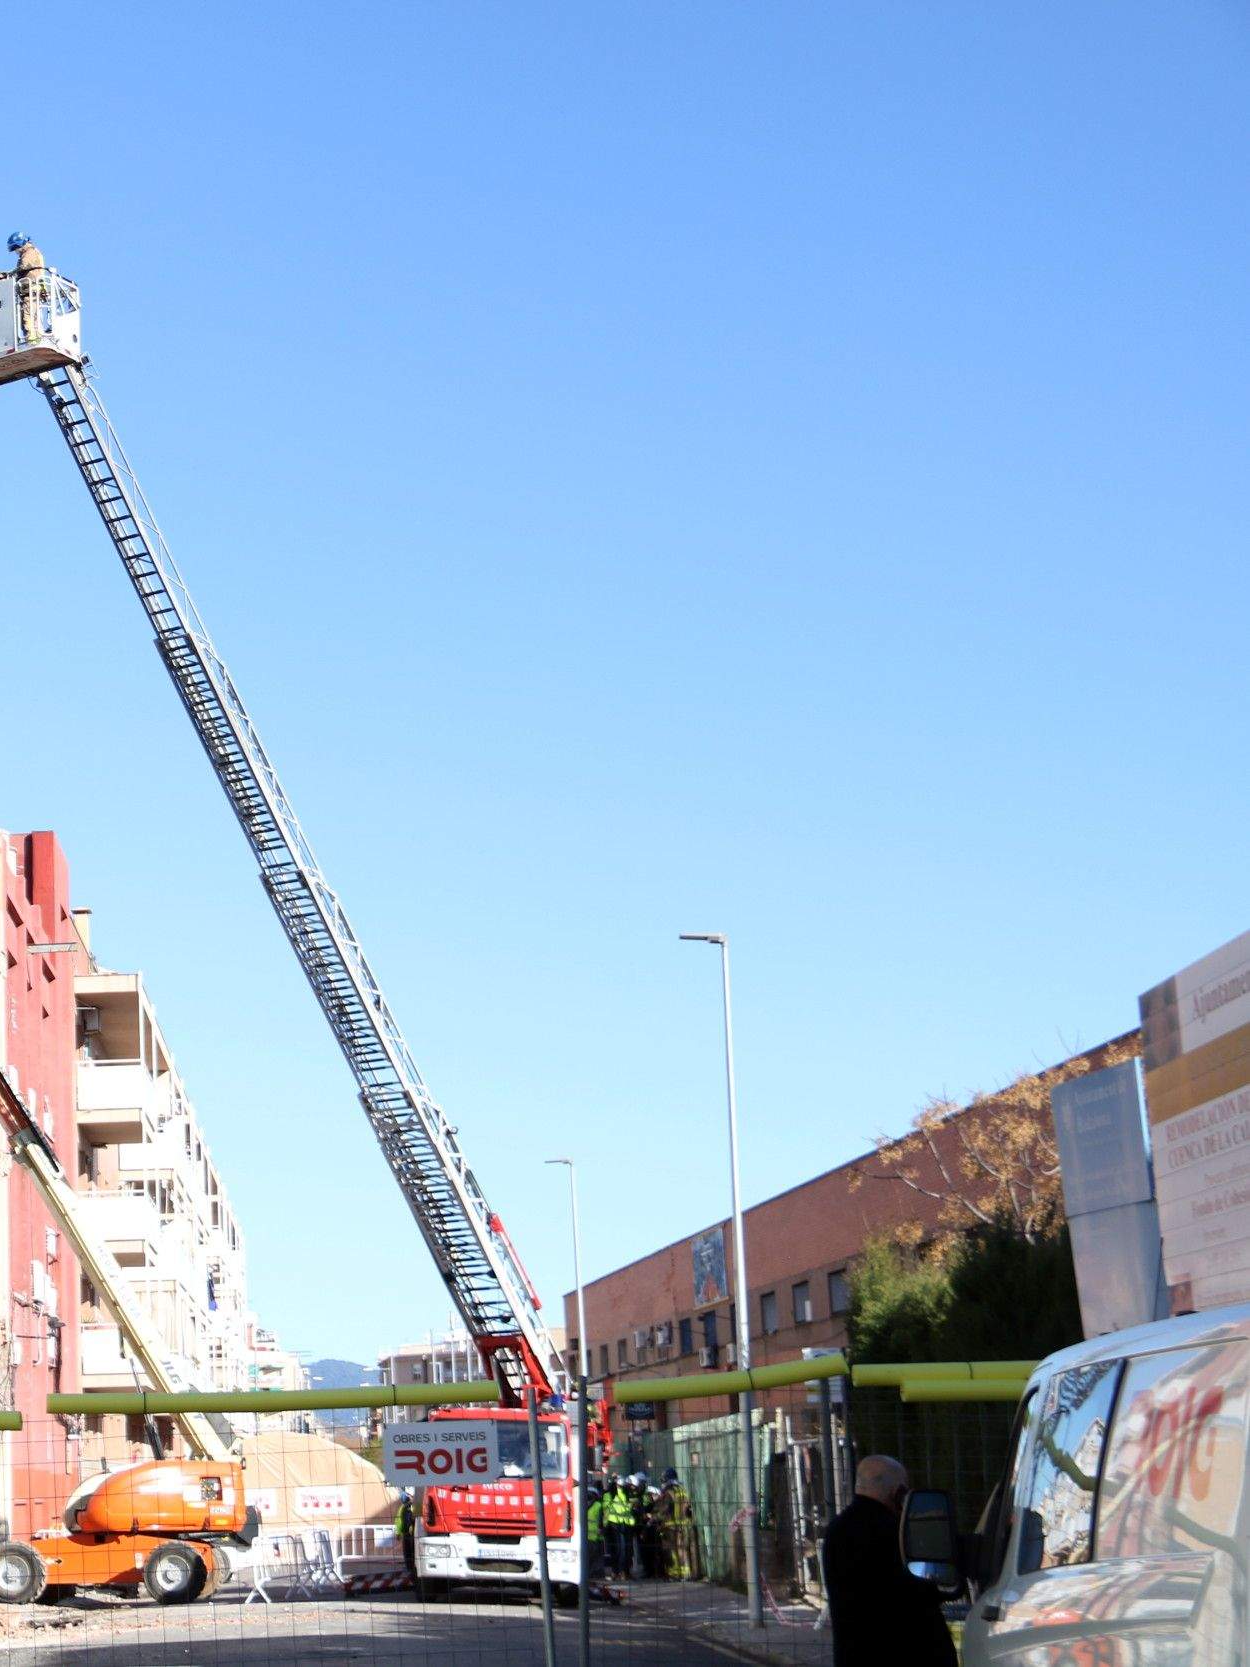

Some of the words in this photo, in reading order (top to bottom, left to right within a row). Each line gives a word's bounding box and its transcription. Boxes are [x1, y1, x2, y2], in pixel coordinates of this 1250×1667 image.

[392, 1433, 430, 1444] OBRES
[441, 1431, 487, 1442] SERVEIS
[394, 1447, 488, 1475] ROIG
